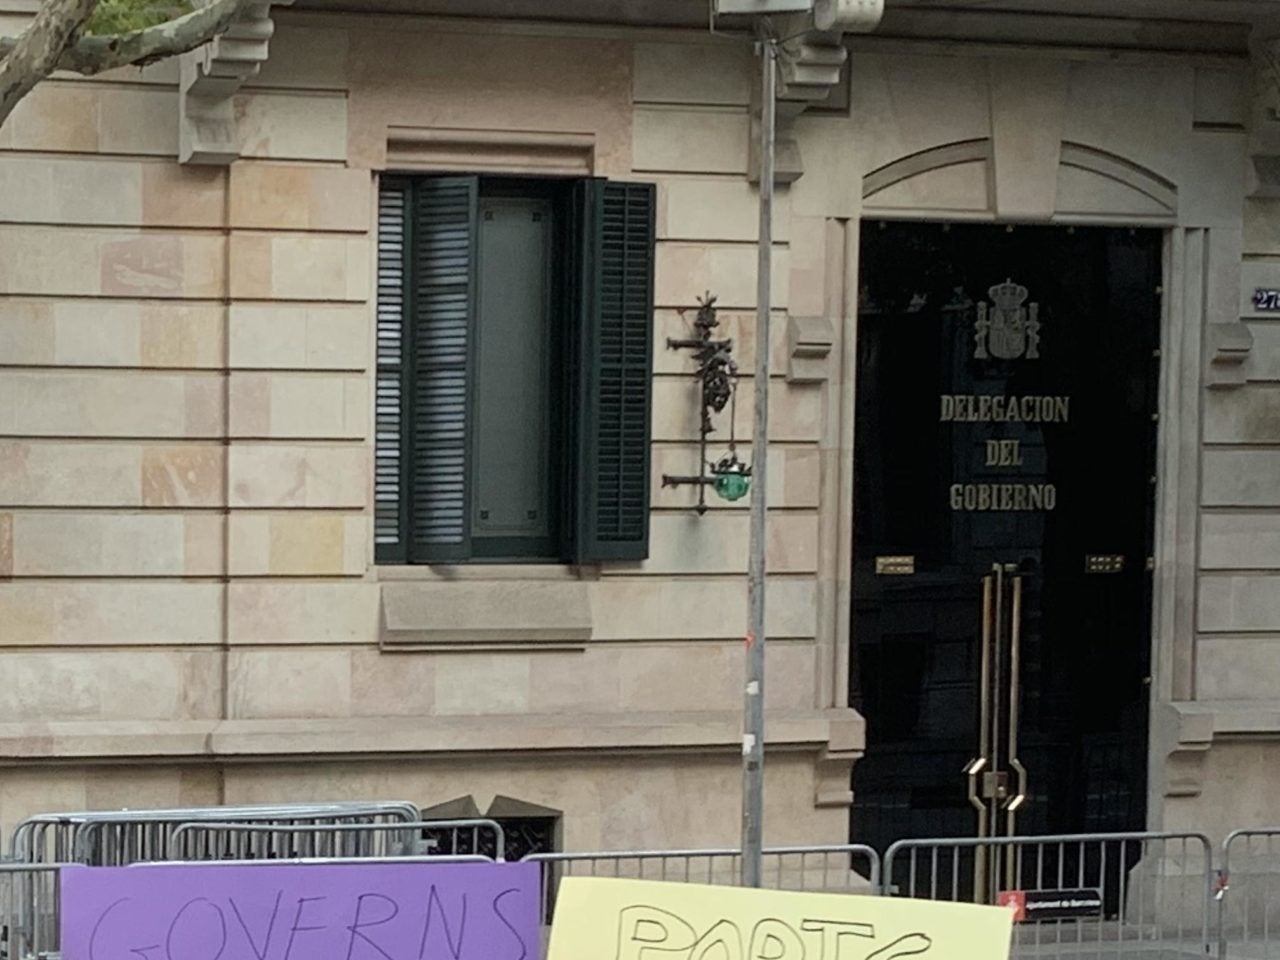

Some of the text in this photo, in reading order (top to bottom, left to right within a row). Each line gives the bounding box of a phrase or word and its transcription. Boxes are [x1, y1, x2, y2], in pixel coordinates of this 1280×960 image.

[940, 395, 1070, 422] DELEGACION
[985, 440, 1023, 466] DEL
[950, 484, 1056, 510] GOBIERNO
